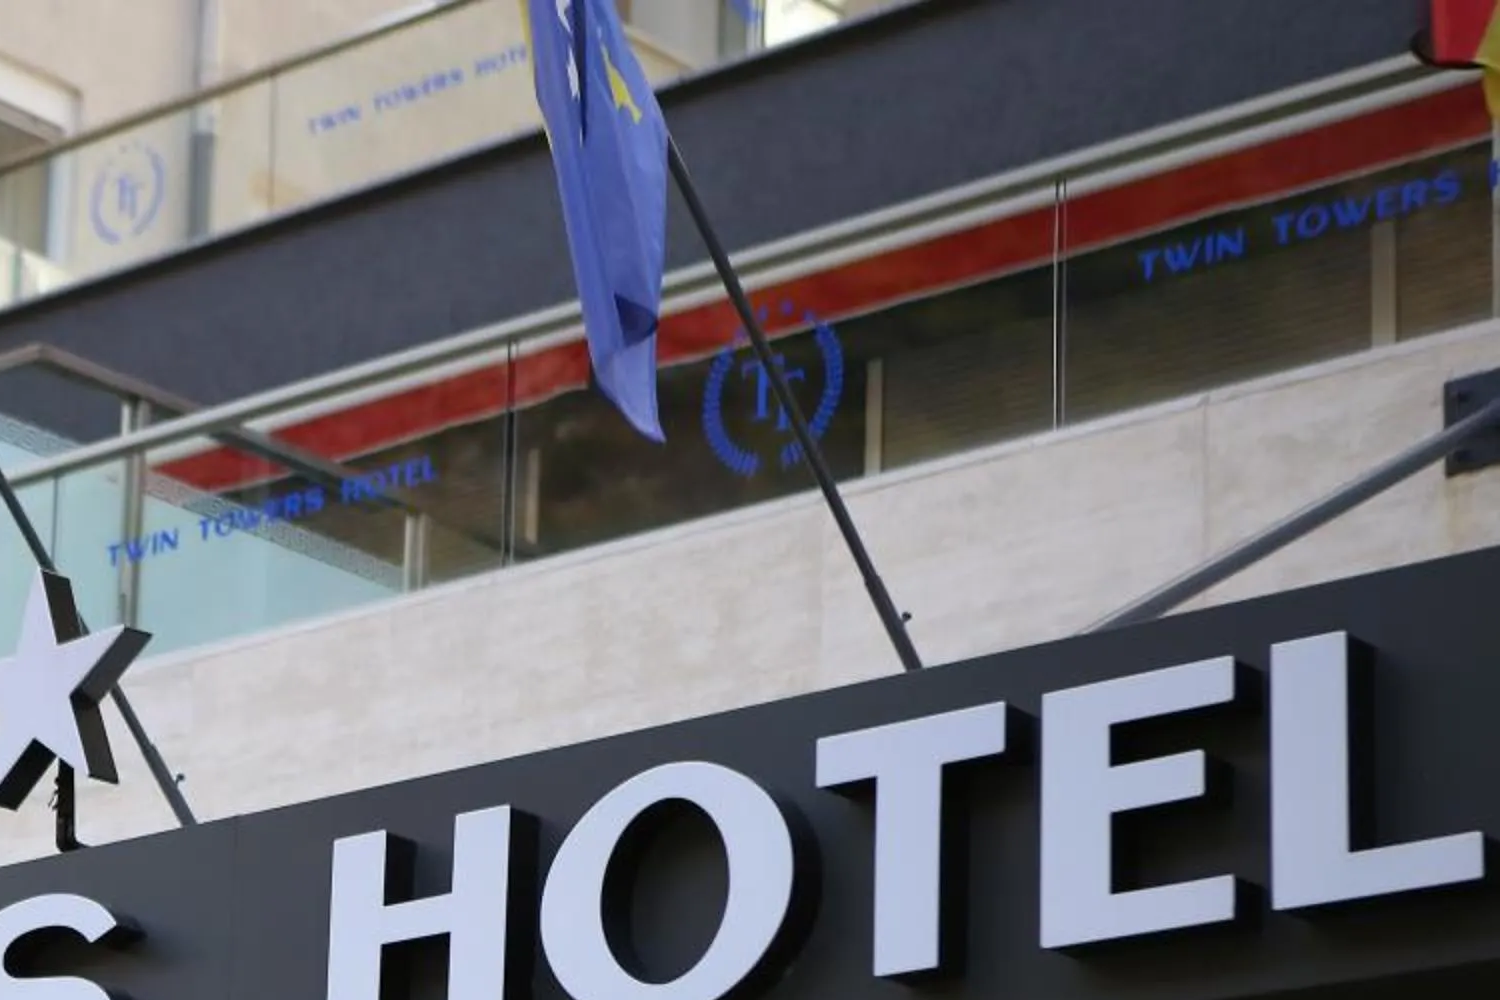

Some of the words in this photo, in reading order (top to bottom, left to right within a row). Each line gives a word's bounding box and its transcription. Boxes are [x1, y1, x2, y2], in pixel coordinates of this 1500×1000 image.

[1138, 226, 1244, 281] TWIN
[1271, 169, 1460, 246] TOWERS
[107, 529, 180, 567] TWIN
[199, 485, 326, 541] TOWERS
[340, 455, 436, 505] HOTEL
